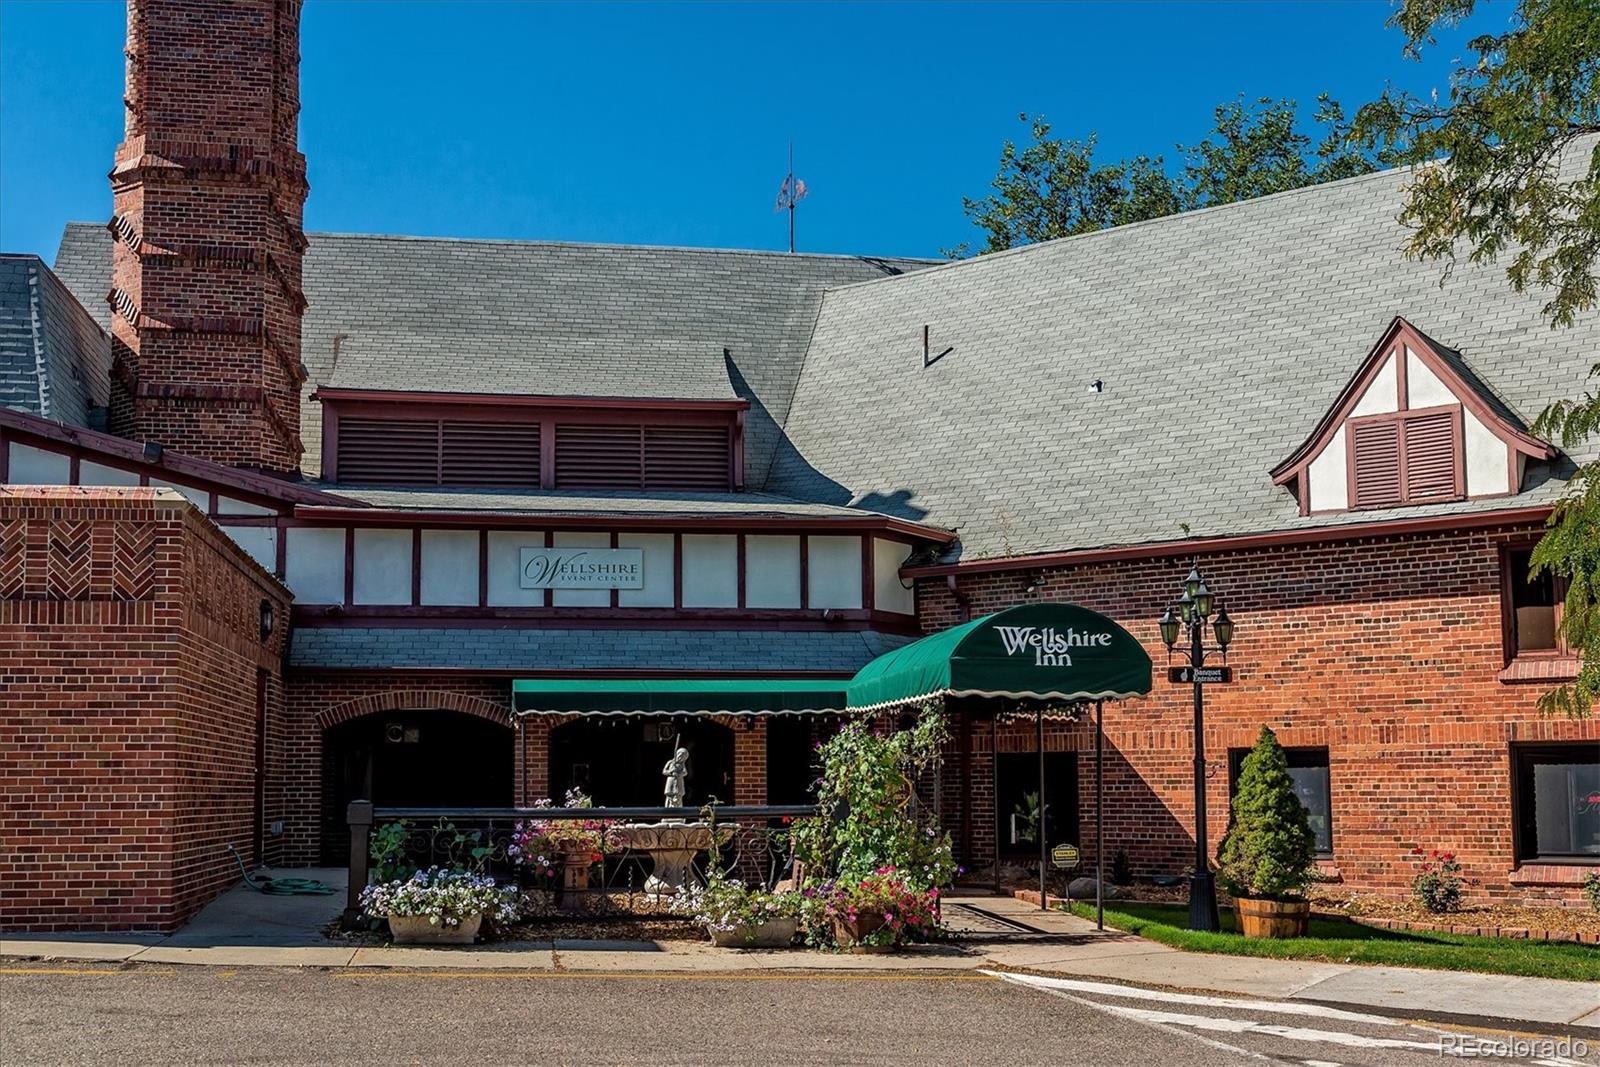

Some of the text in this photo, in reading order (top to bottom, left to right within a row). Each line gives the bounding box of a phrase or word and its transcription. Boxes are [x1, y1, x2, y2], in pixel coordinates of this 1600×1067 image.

[524, 552, 638, 584] WELLSHIRE
[992, 626, 1112, 656] Wellshire
[1035, 646, 1073, 666] Inn
[1193, 668, 1222, 676] Banquet
